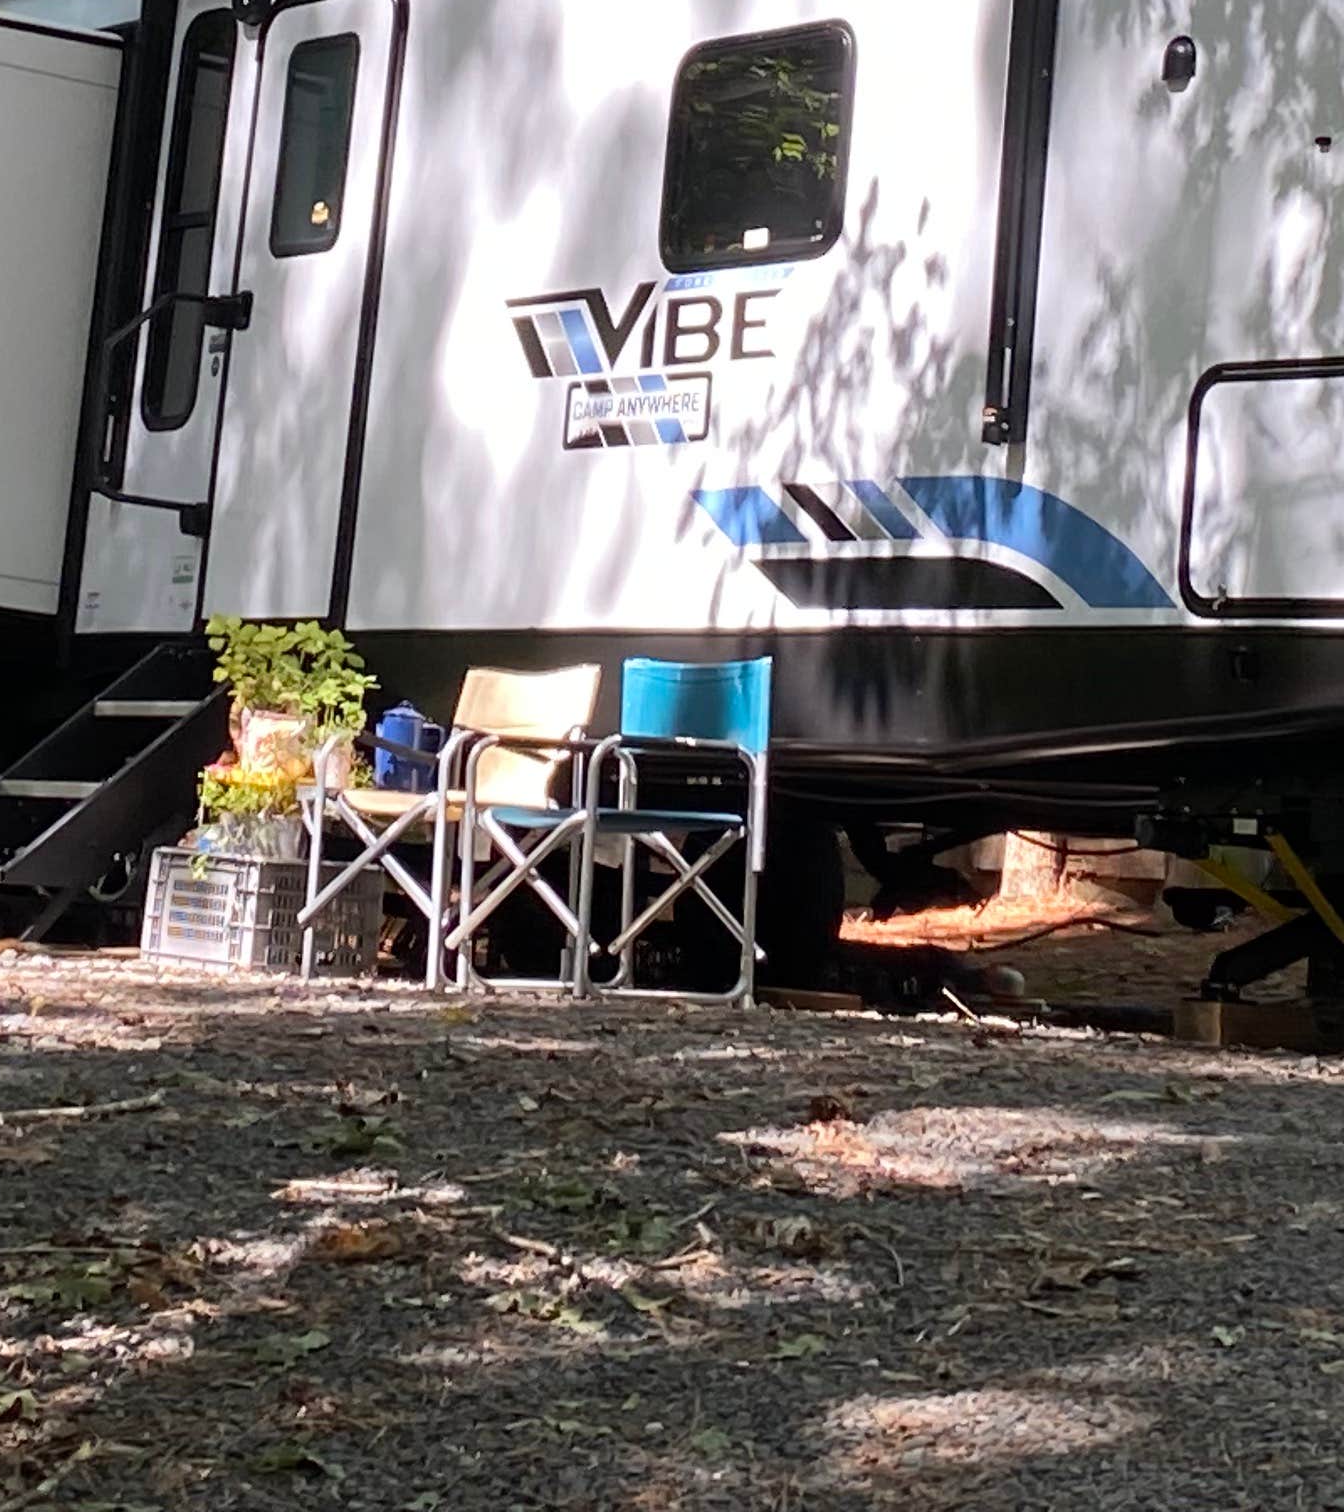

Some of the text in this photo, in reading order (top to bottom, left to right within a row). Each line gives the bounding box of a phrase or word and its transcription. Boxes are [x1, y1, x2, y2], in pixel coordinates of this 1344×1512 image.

[505, 280, 782, 372] VIBE
[572, 391, 701, 421] CAMP ANYWHERE
